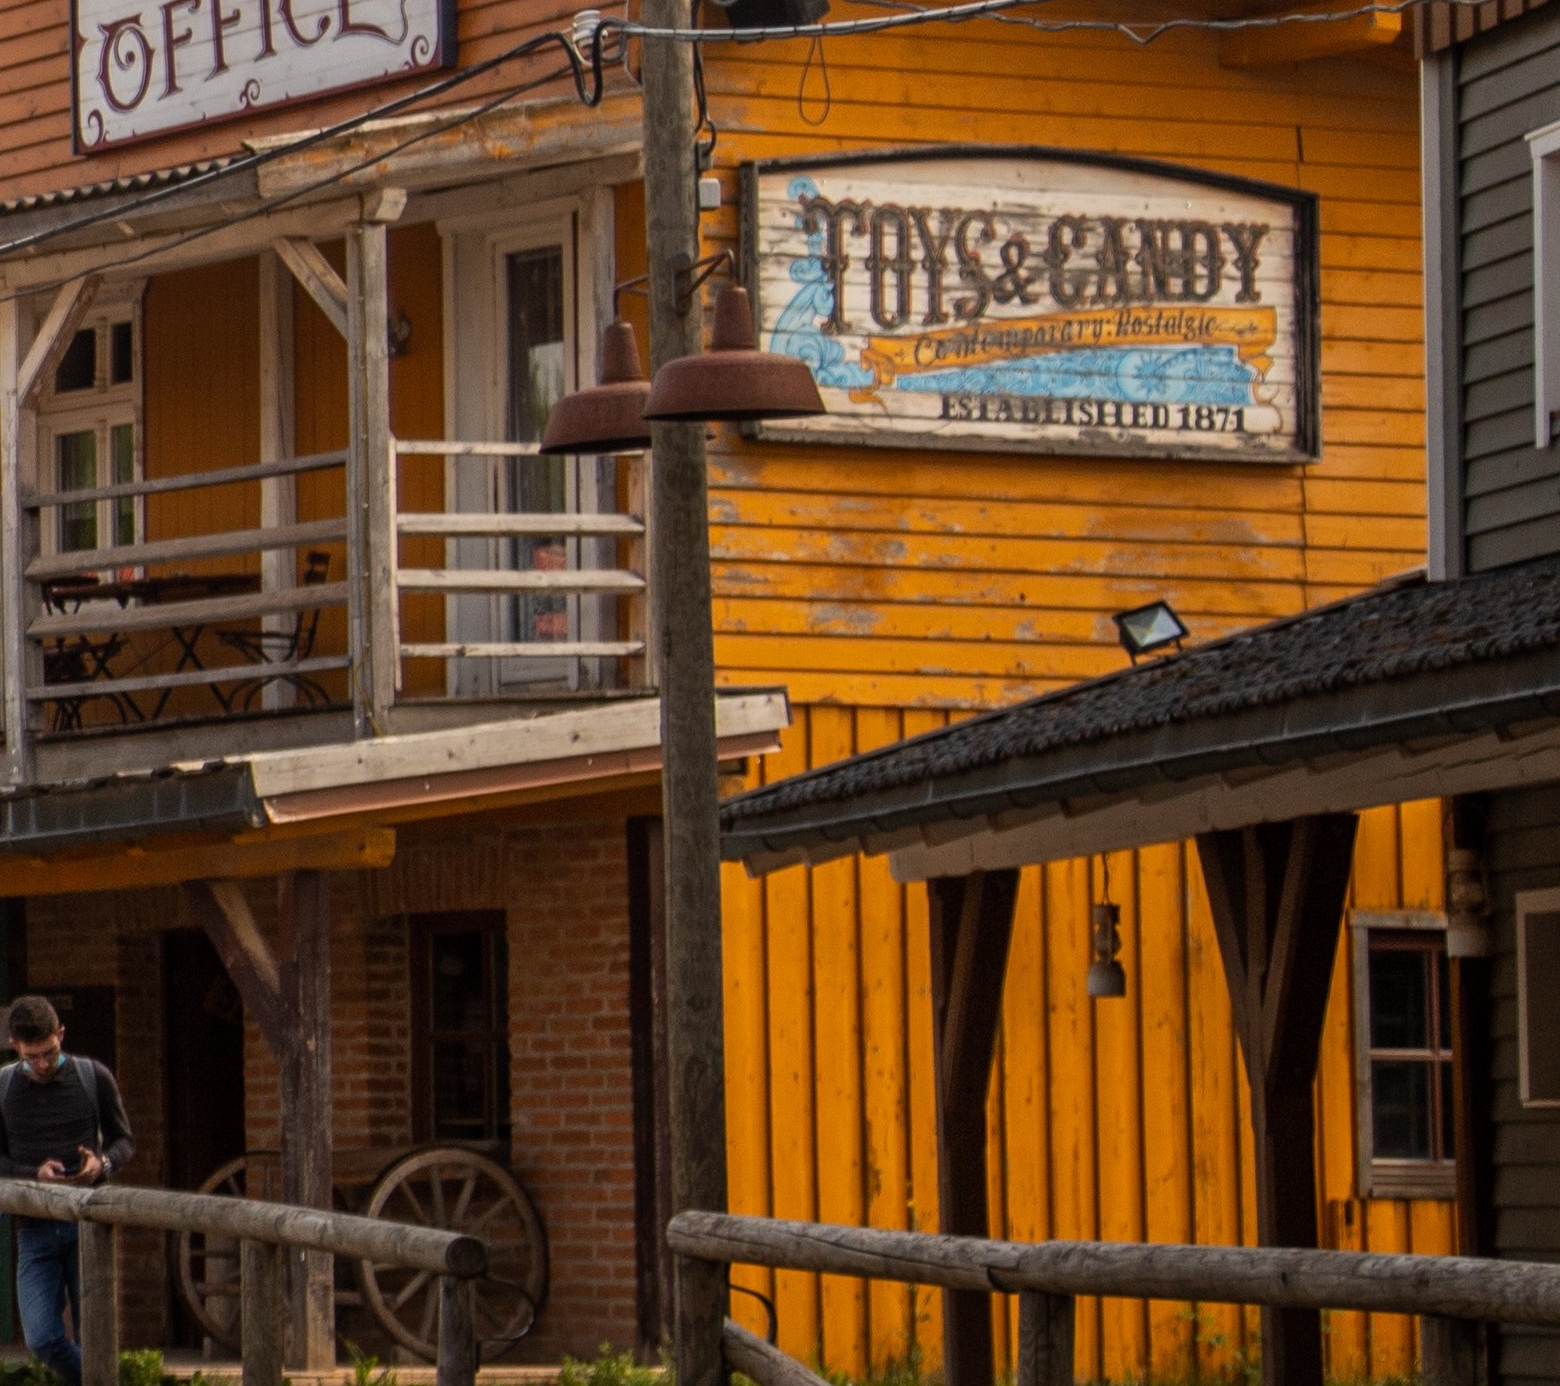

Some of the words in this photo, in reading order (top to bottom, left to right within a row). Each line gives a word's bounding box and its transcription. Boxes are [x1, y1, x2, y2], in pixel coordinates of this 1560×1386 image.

[798, 195, 998, 335] TOYS
[1046, 212, 1271, 307] CANDY
[940, 394, 1169, 429] ESTABLISHED
[1177, 405, 1246, 433] 1871
